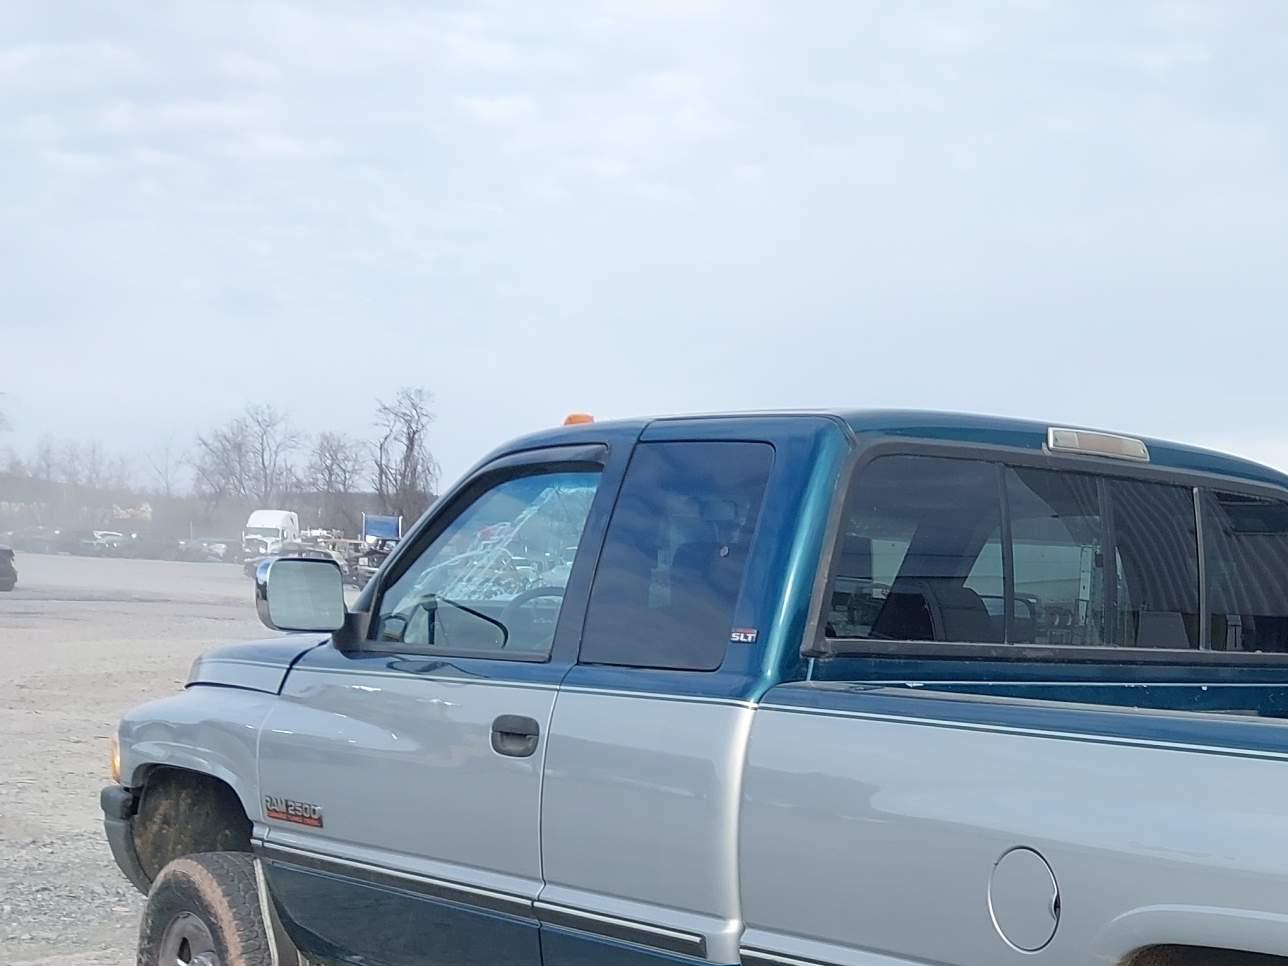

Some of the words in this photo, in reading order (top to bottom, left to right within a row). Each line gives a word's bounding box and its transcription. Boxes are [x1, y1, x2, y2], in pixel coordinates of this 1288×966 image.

[730, 631, 756, 643] SLT
[264, 795, 288, 813] RAM
[287, 800, 321, 820] 2500
